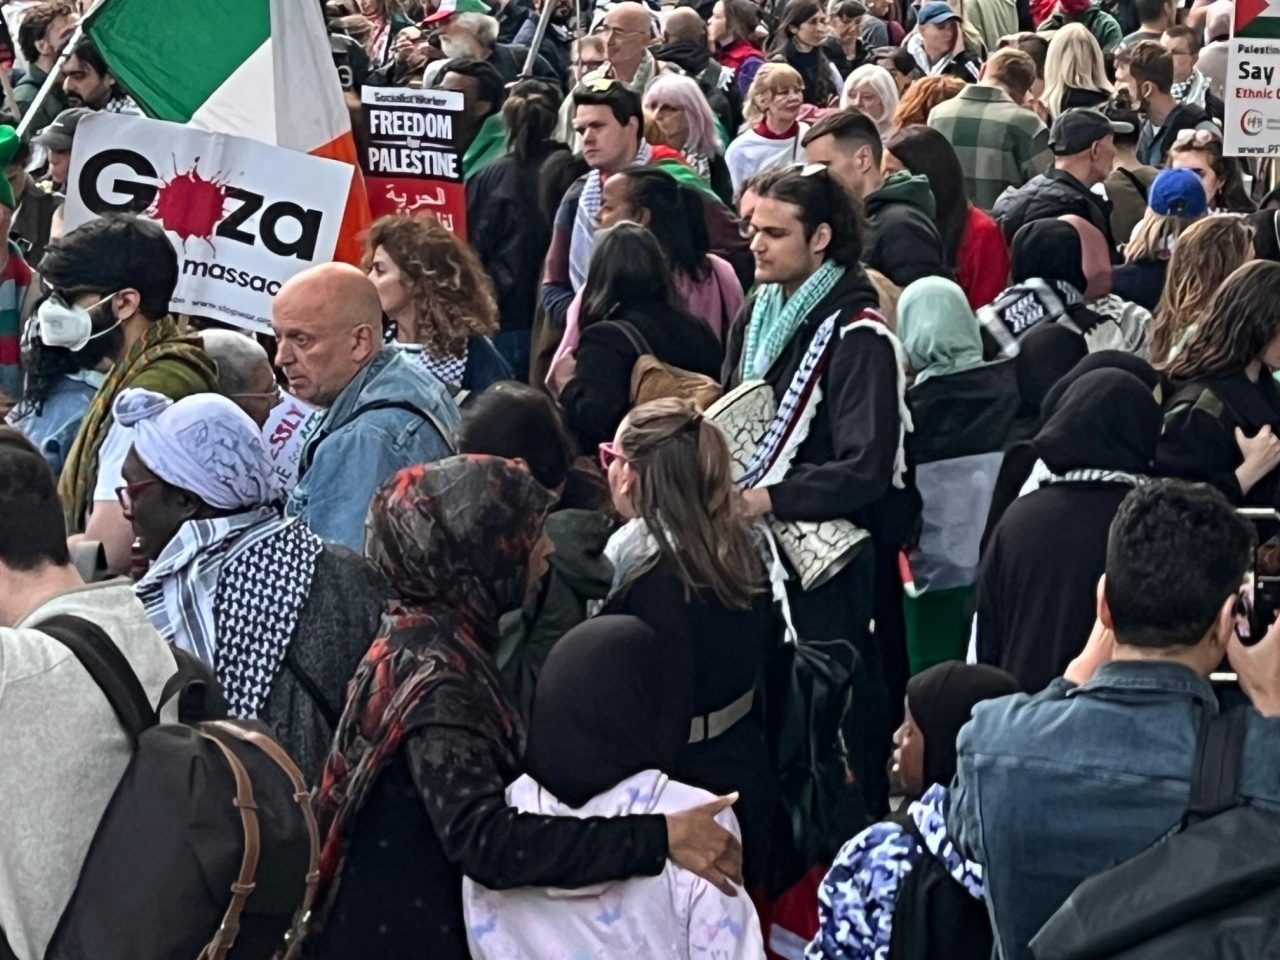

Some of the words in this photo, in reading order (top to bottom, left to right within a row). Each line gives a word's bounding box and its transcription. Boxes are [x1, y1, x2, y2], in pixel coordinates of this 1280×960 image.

[1238, 61, 1274, 85] Say
[1235, 87, 1273, 99] Ethnic
[370, 110, 453, 140] FREEDOM
[368, 147, 459, 178] PALESTINE
[78, 148, 323, 261] Gza
[183, 259, 282, 296] massac
